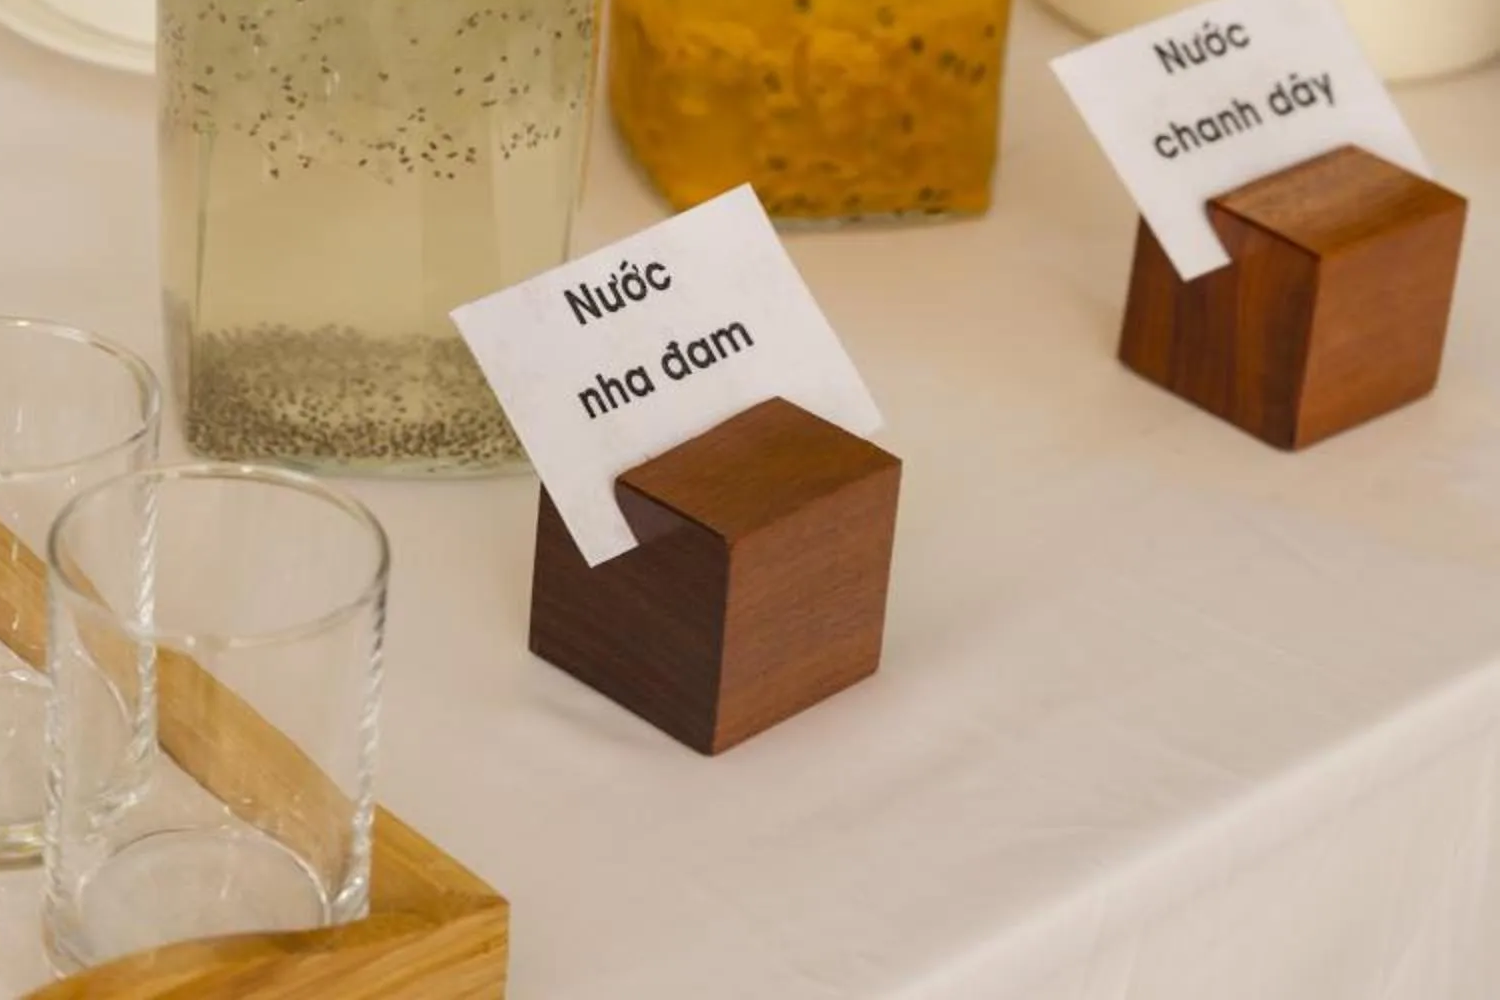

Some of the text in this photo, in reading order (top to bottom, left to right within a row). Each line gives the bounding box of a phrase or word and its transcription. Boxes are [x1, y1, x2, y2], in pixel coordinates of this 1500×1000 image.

[1152, 18, 1251, 74] Nước
[1153, 99, 1263, 159] chanh
[563, 260, 672, 326] Nước
[577, 321, 755, 420] nha đam
